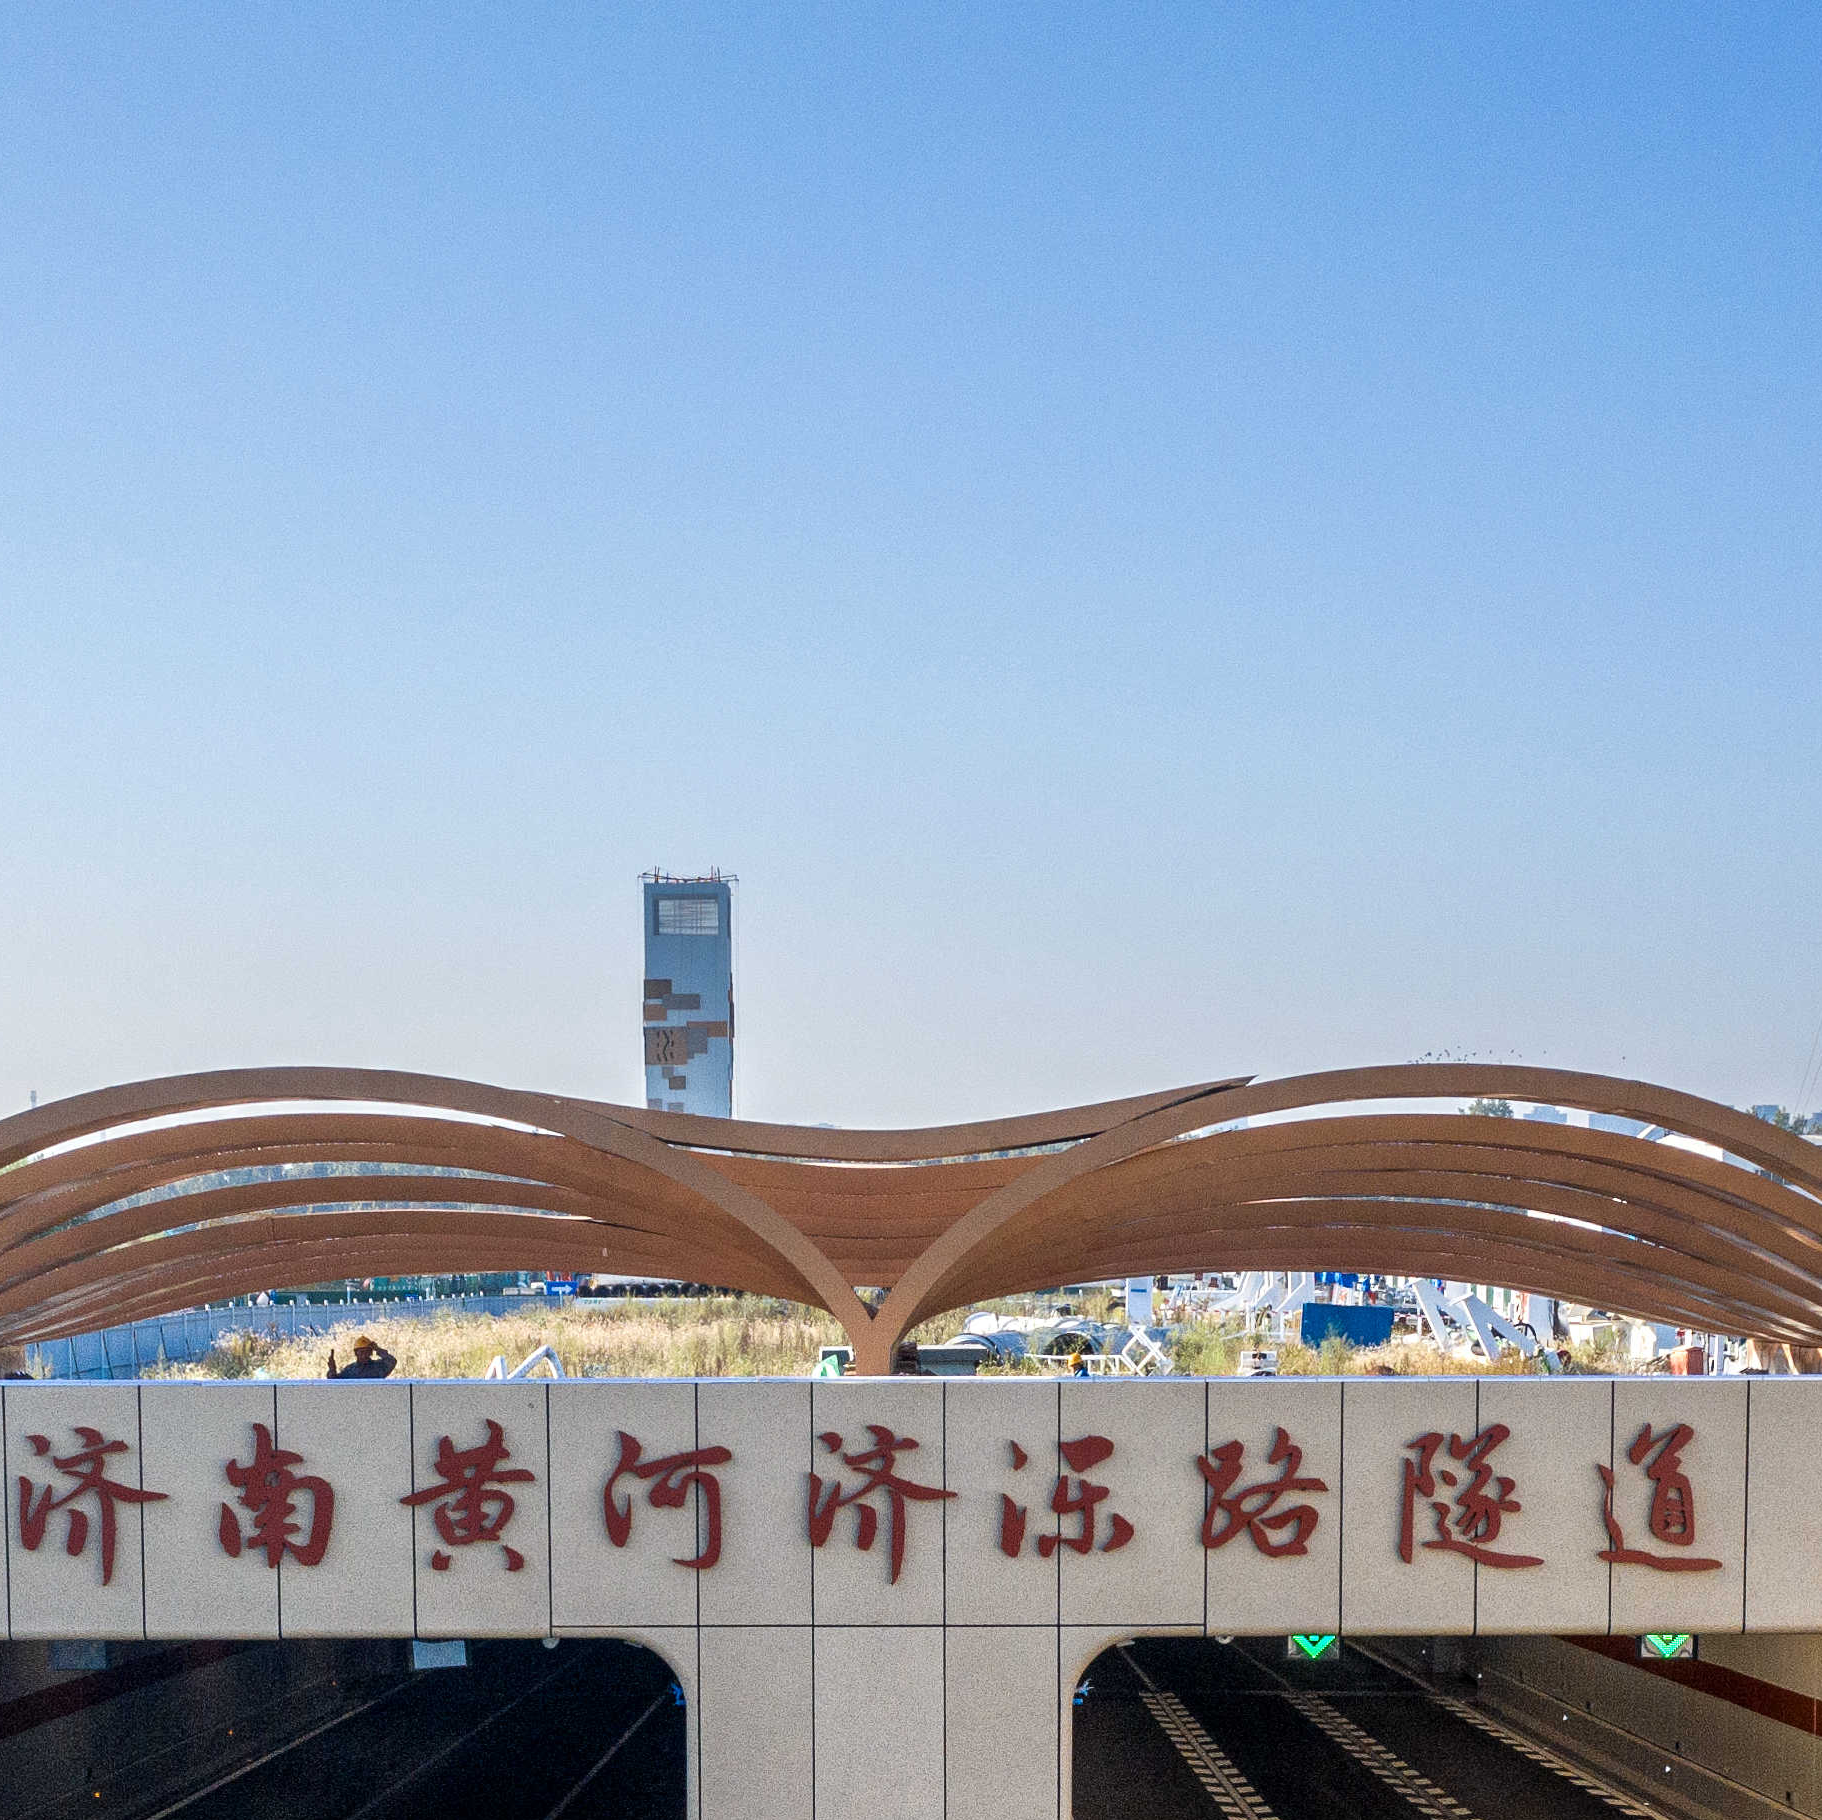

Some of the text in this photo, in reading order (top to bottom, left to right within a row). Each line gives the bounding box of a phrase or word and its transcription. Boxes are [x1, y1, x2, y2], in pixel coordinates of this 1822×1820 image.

[18, 1420, 1723, 1587] 济南黄河济泺路隧道
